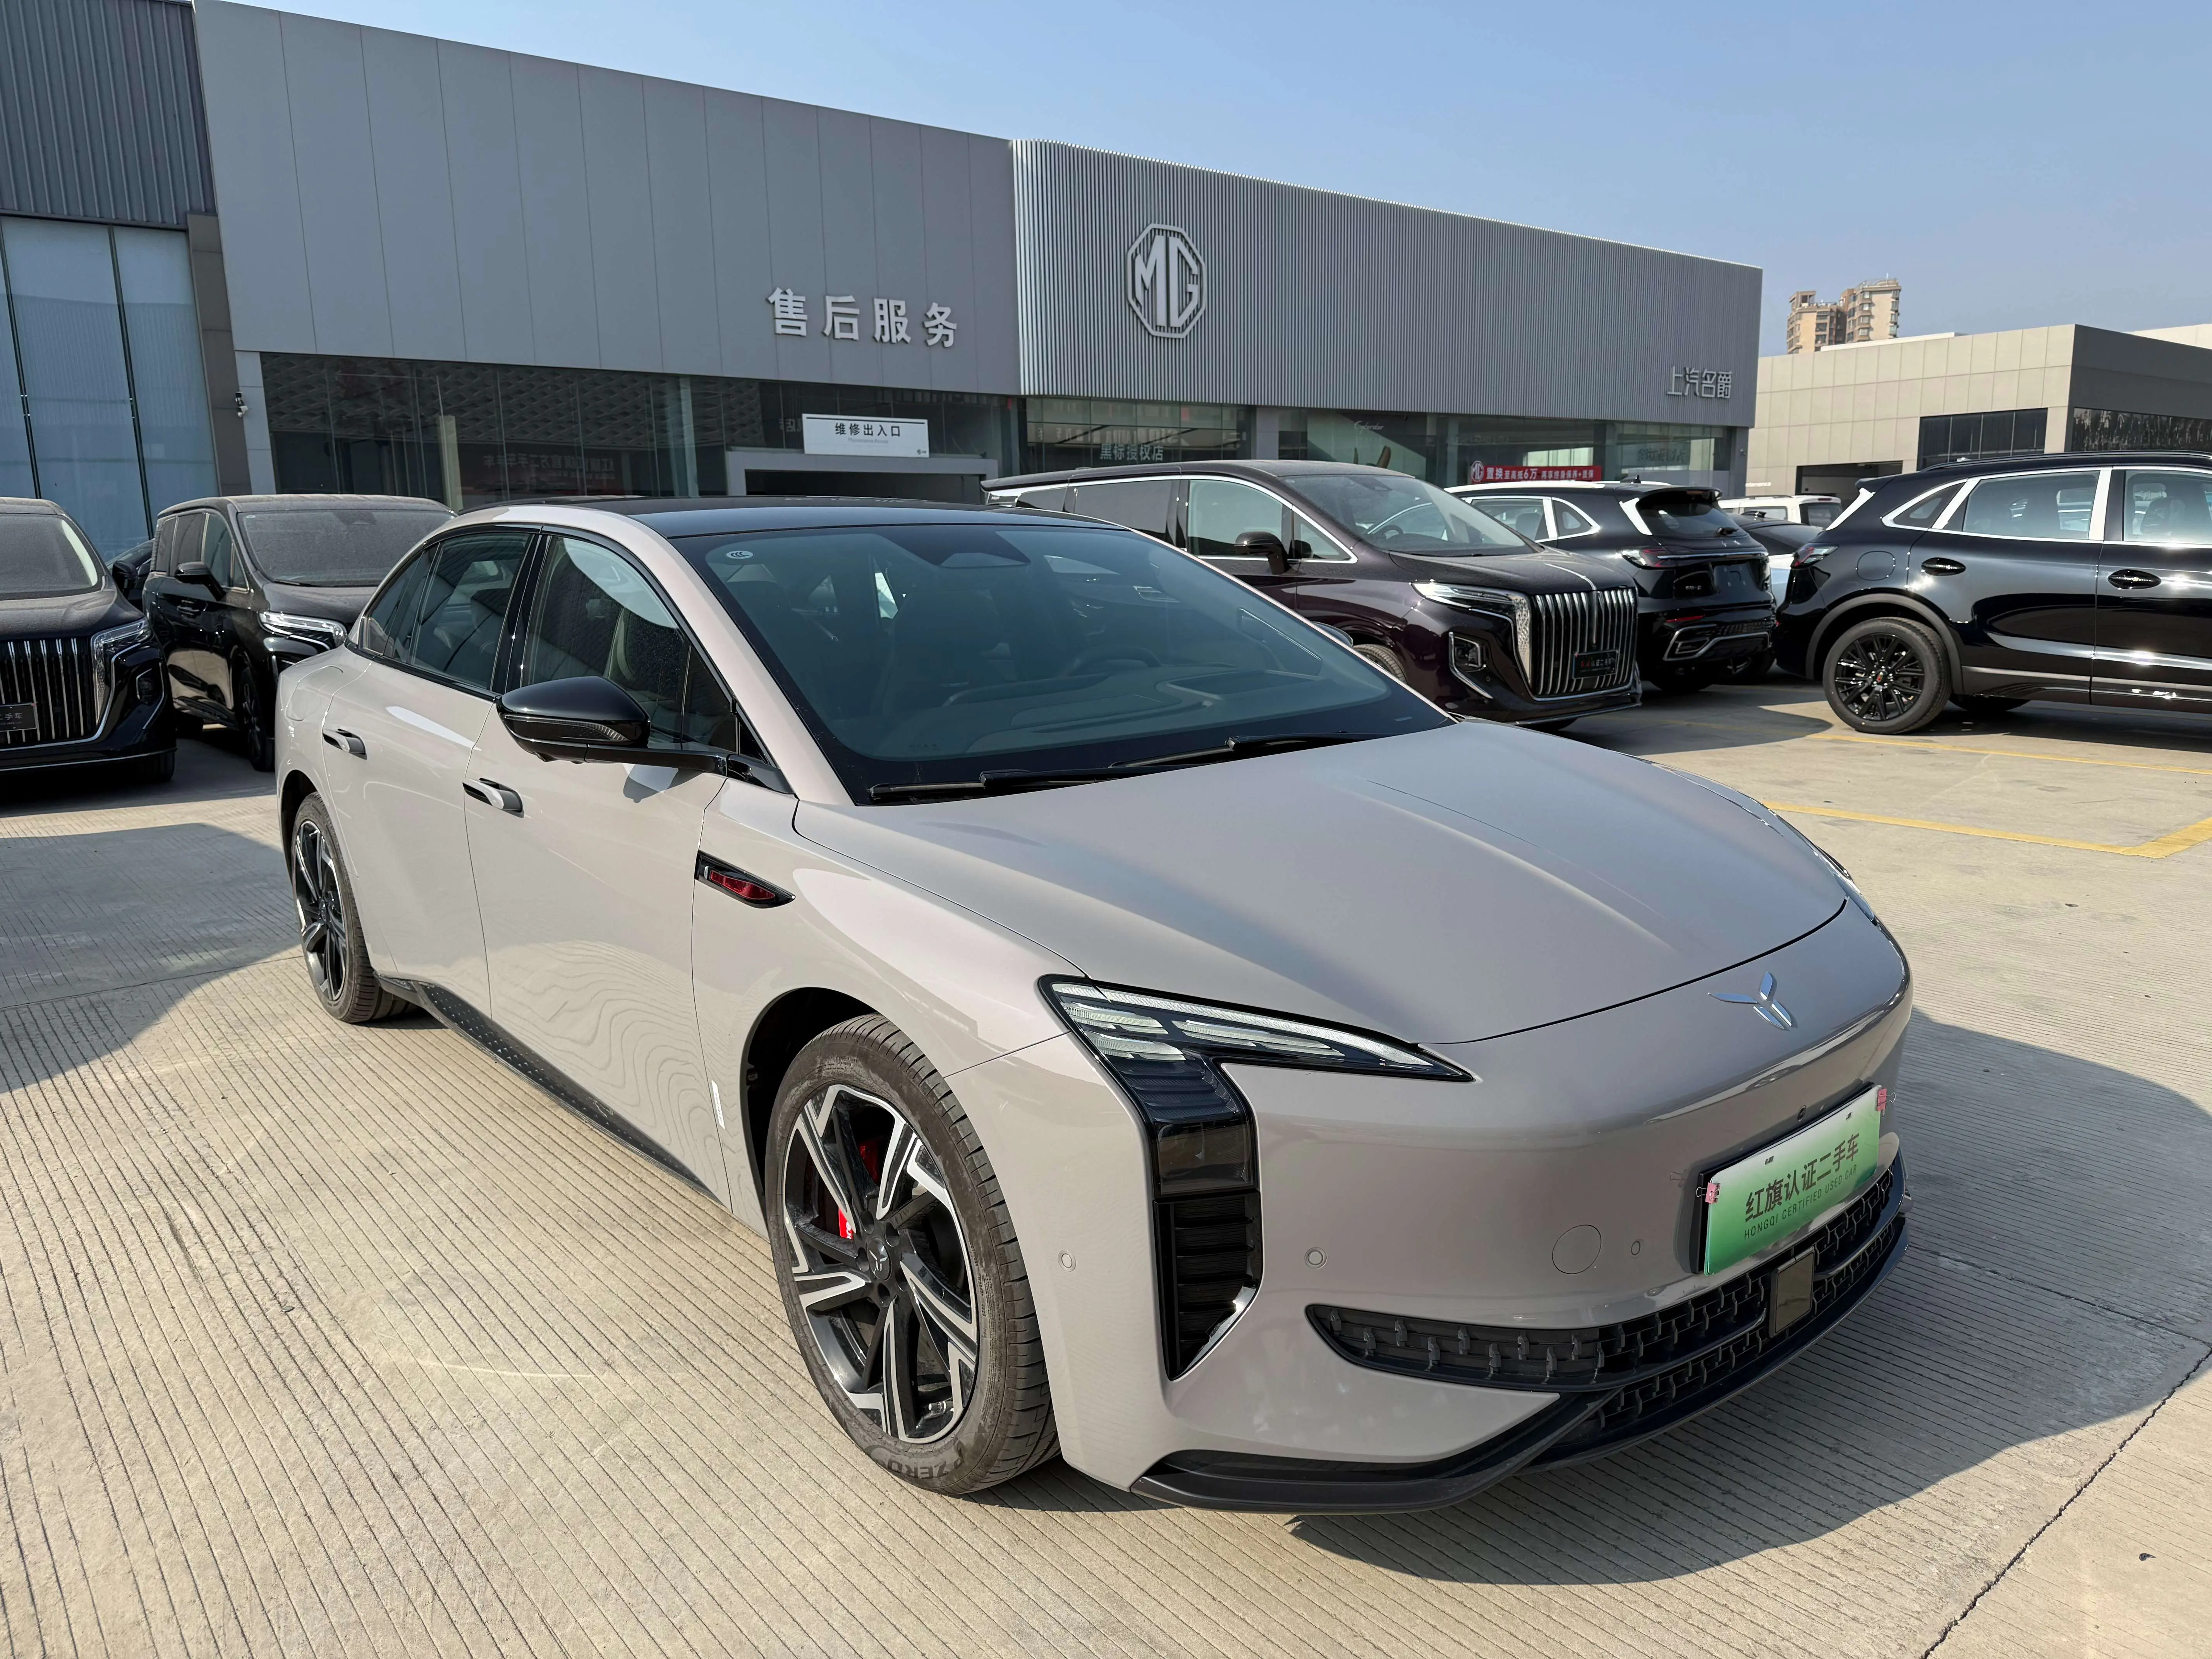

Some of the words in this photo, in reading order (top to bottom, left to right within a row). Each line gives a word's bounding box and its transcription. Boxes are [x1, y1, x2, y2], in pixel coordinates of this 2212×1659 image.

[1135, 234, 1198, 328] MG
[766, 287, 957, 348] 售后服务
[1666, 366, 1732, 399] 上汽名爵
[835, 422, 900, 437] 维修出入口
[1100, 443, 1164, 461] 黑标授权店
[1745, 1133, 1860, 1223] 红旗认证二手车
[1744, 1214, 1779, 1240] HONGQI
[1782, 1189, 1822, 1219] CERTIFIED
[1825, 1175, 1843, 1194] USED
[1844, 1164, 1857, 1181] CAR
[887, 1459, 949, 1479] ZERO
